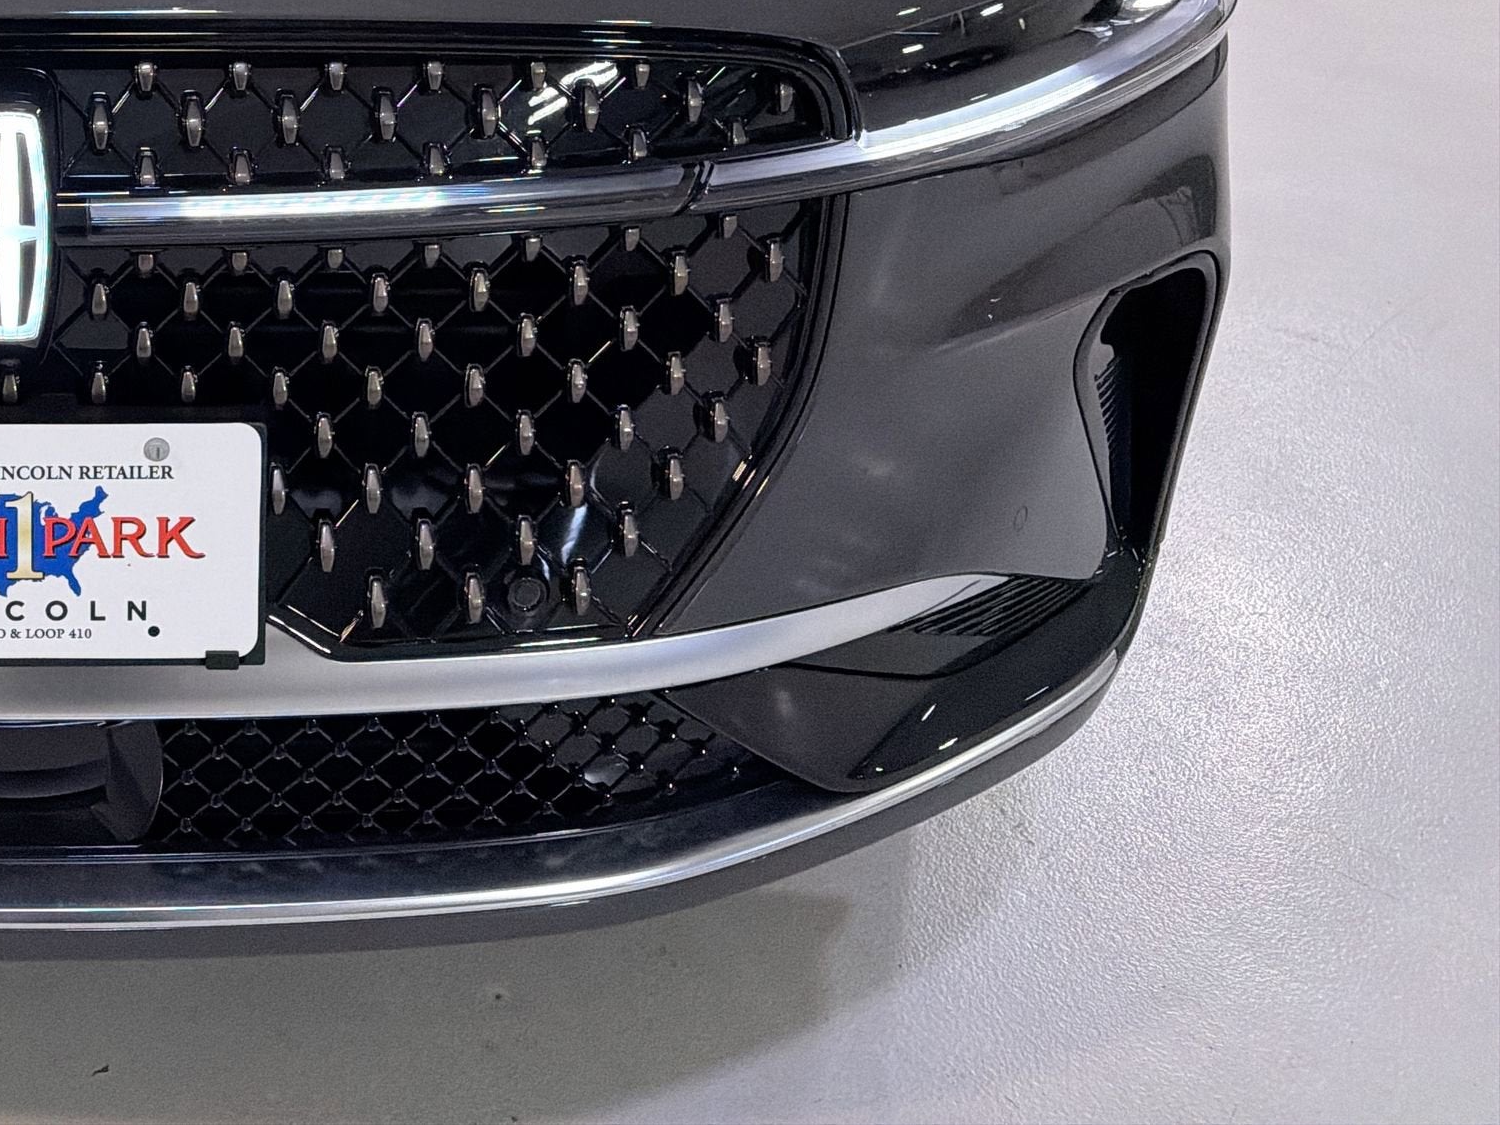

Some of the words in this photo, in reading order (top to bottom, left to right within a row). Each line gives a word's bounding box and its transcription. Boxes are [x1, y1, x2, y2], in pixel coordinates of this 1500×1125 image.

[78, 465, 175, 481] RETAILER
[43, 516, 206, 559] PARK
[10, 628, 22, 640] &
[25, 628, 66, 640] LOOP
[68, 628, 93, 640] 410
